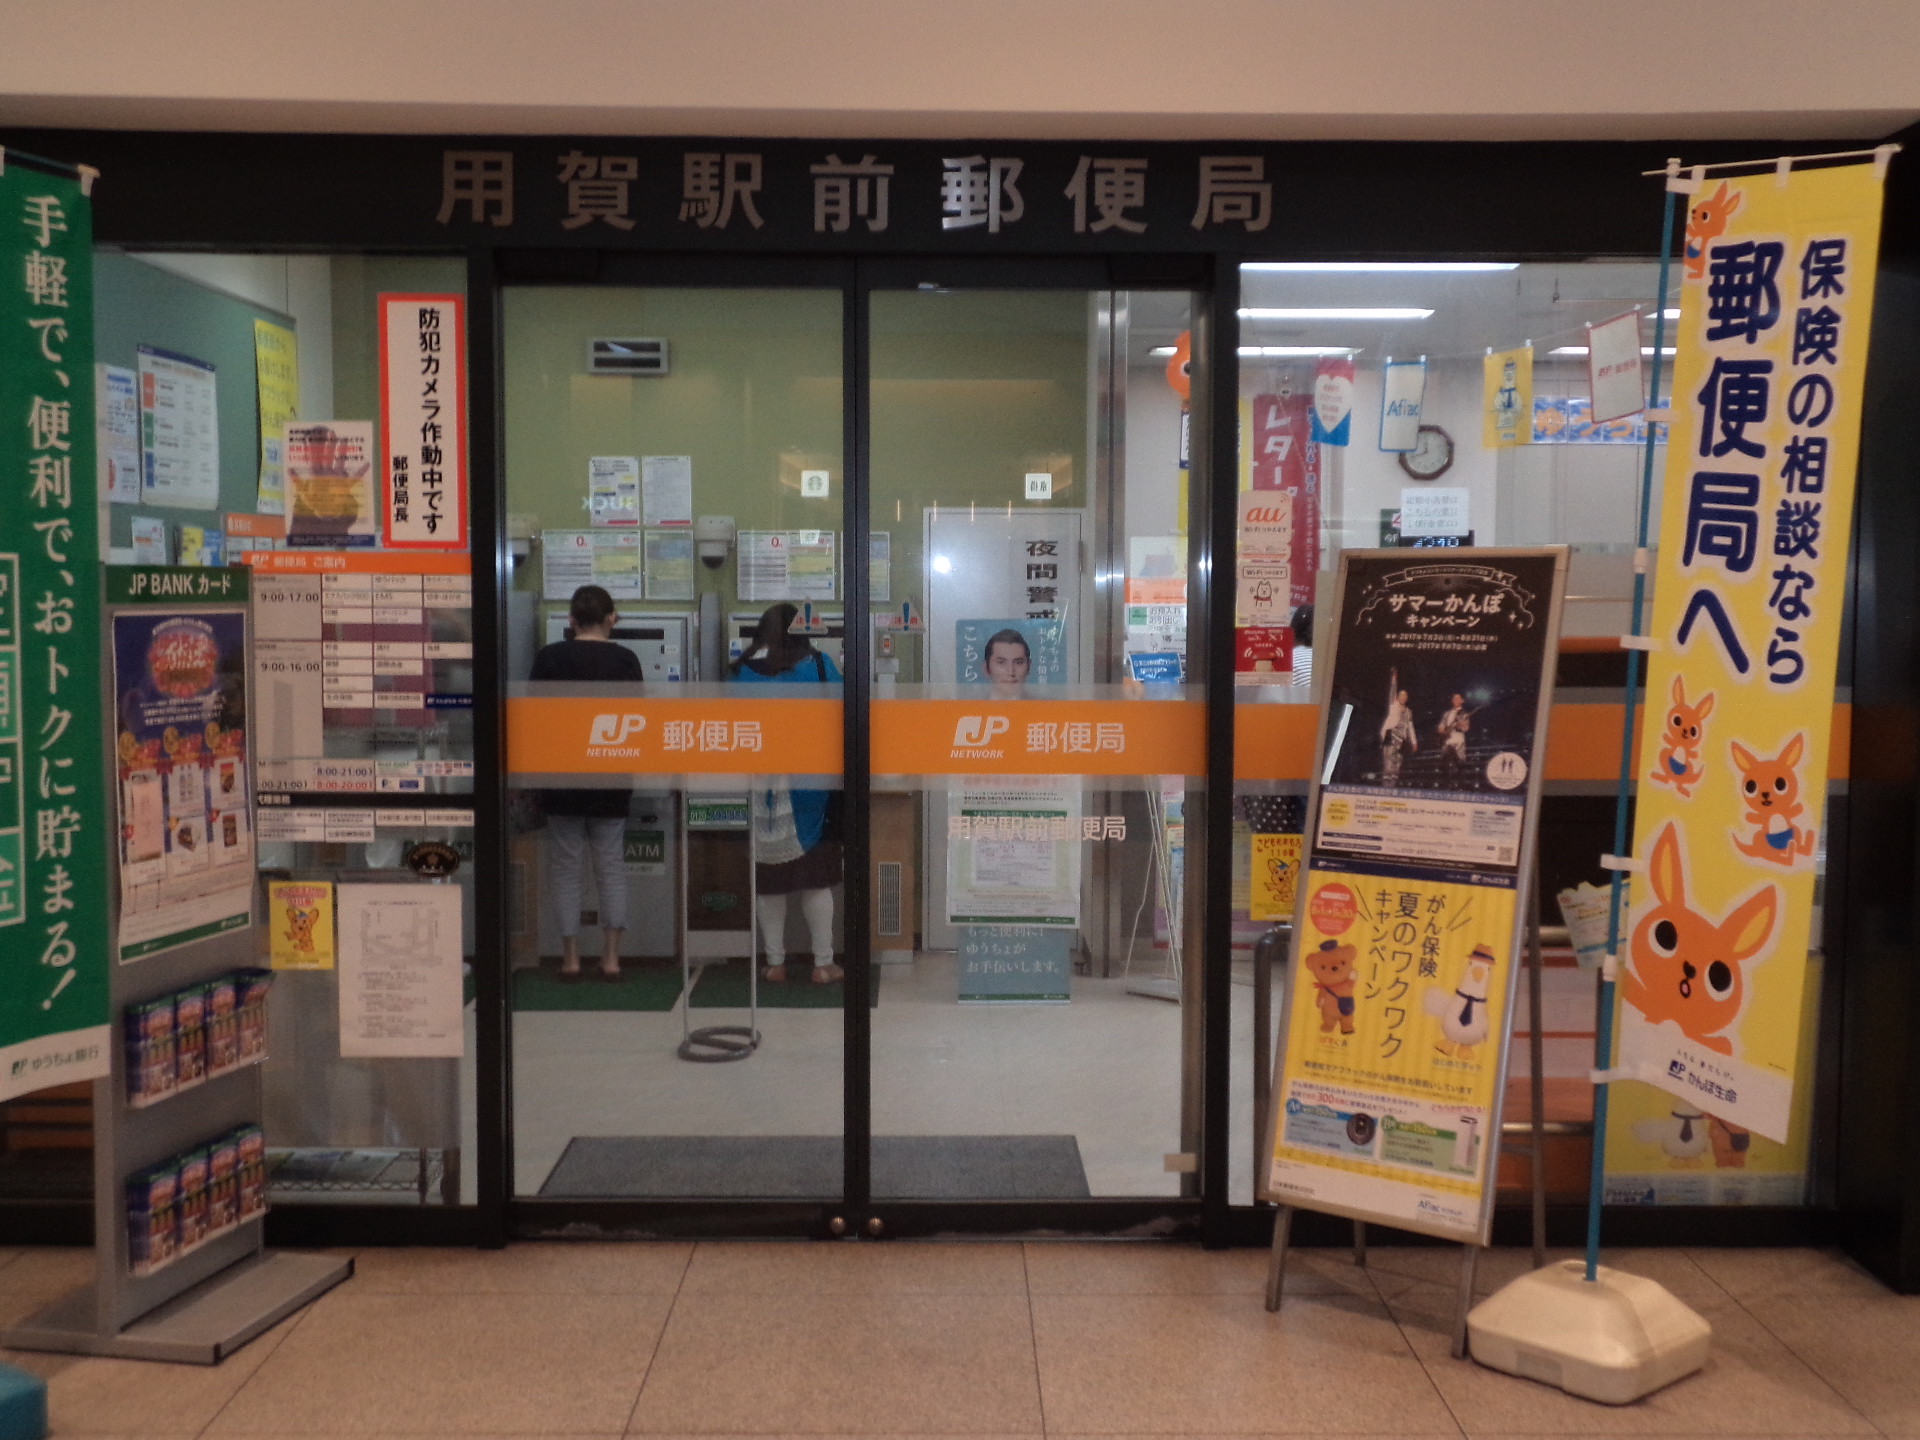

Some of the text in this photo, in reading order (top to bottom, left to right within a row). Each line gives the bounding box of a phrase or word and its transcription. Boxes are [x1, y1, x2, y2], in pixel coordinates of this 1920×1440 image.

[436, 151, 1275, 234] 用賀駅前郵便局
[417, 307, 444, 535] 防犯カメラ作動中です
[1386, 400, 1419, 417] Aflac
[1676, 239, 1784, 676] 郵便局へ
[1766, 238, 1846, 686] 保険の相談なら
[392, 455, 410, 523] 郵便局長
[1246, 507, 1287, 523] au
[128, 572, 232, 596] JP BANK カード
[1389, 591, 1506, 615] サマーかんぽ
[1406, 613, 1481, 628] キャンペーン
[962, 626, 979, 682] こちら
[585, 747, 641, 758] NETWORK
[589, 714, 763, 753] JP 郵便局
[952, 715, 1126, 754] JP 郵便局
[950, 749, 1005, 760] NETWORK
[625, 842, 660, 857] ATM
[1364, 889, 1393, 999] キャンペーン
[1418, 893, 1447, 979] がん保険
[966, 960, 1059, 974] お手伝いします。
[1380, 890, 1422, 1059] 夏のワクワク
[1688, 1071, 1738, 1104] かんぽ生命
